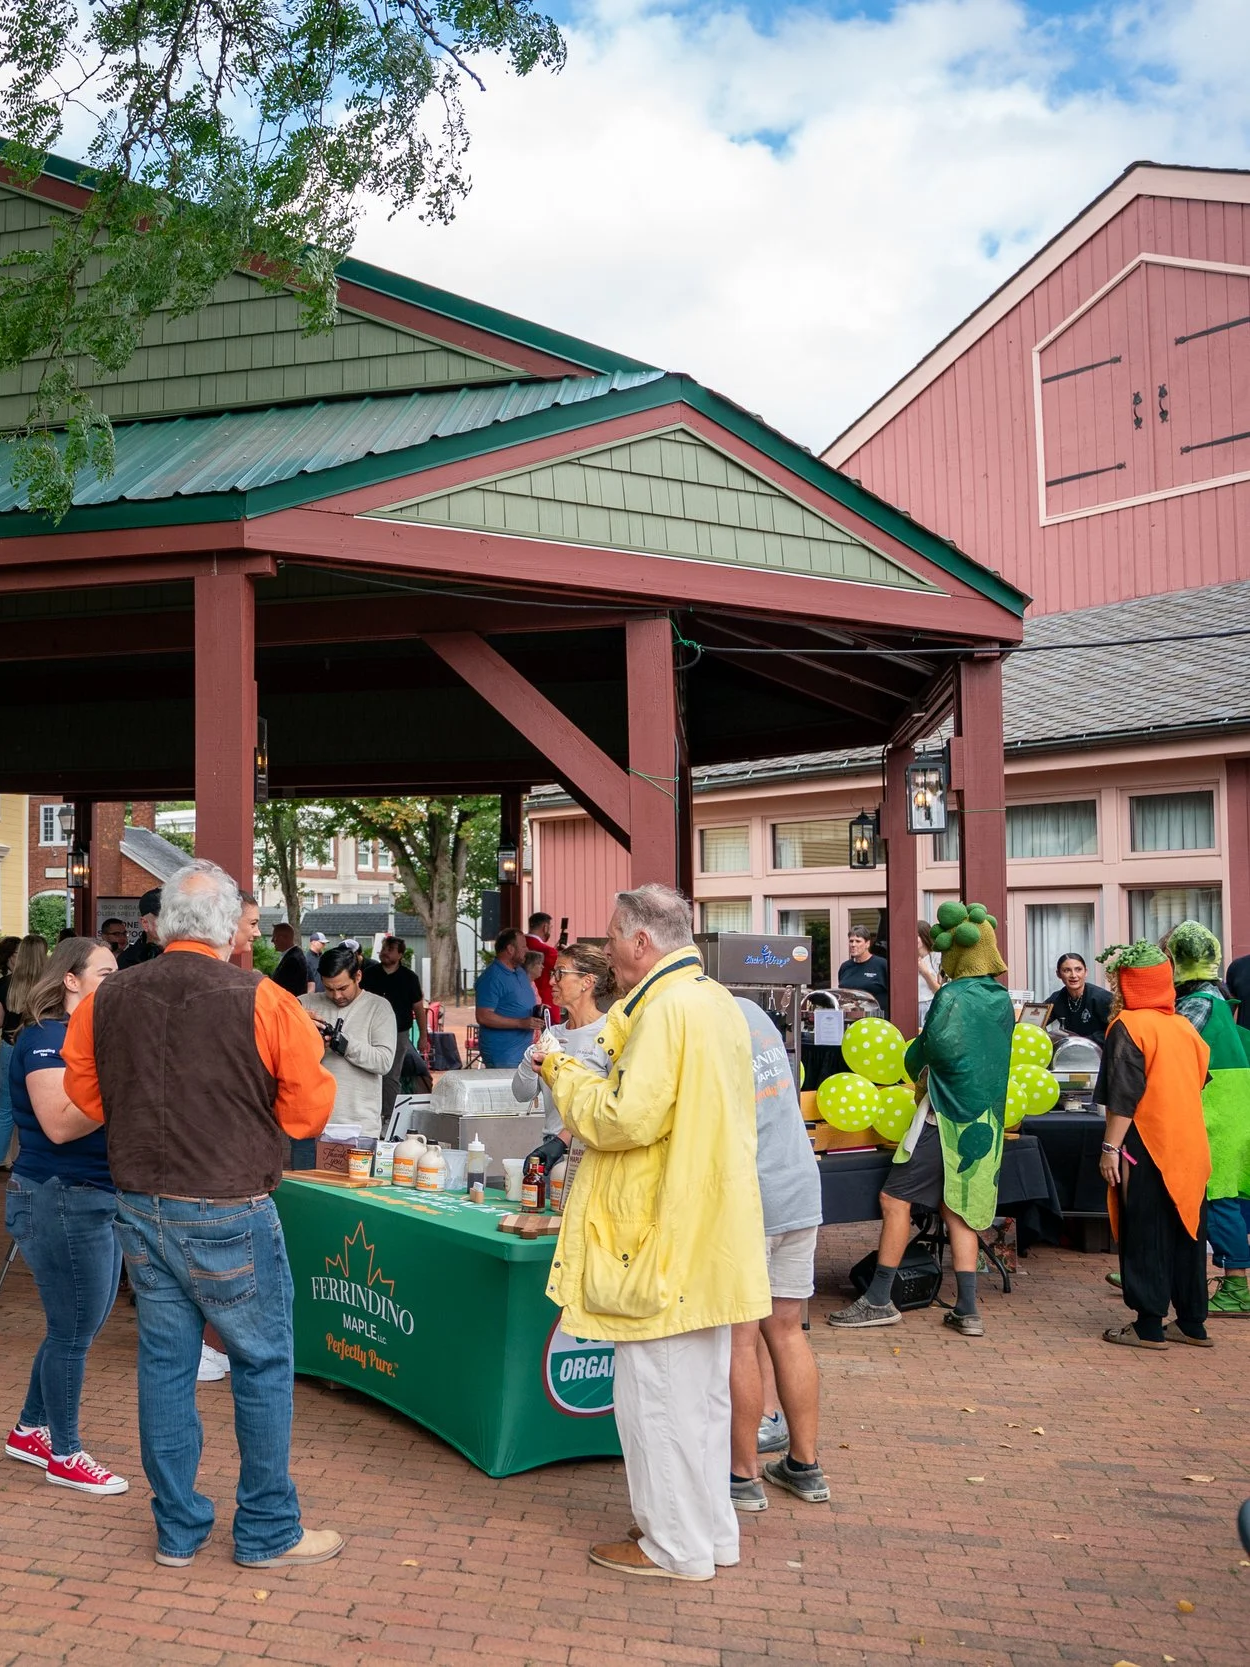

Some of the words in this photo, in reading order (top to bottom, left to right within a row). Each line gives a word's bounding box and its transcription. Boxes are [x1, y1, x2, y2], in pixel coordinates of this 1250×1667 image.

[311, 1276, 414, 1335] FERRINDINO
[343, 1313, 377, 1340] MAPLE
[326, 1332, 367, 1369] Perfectly
